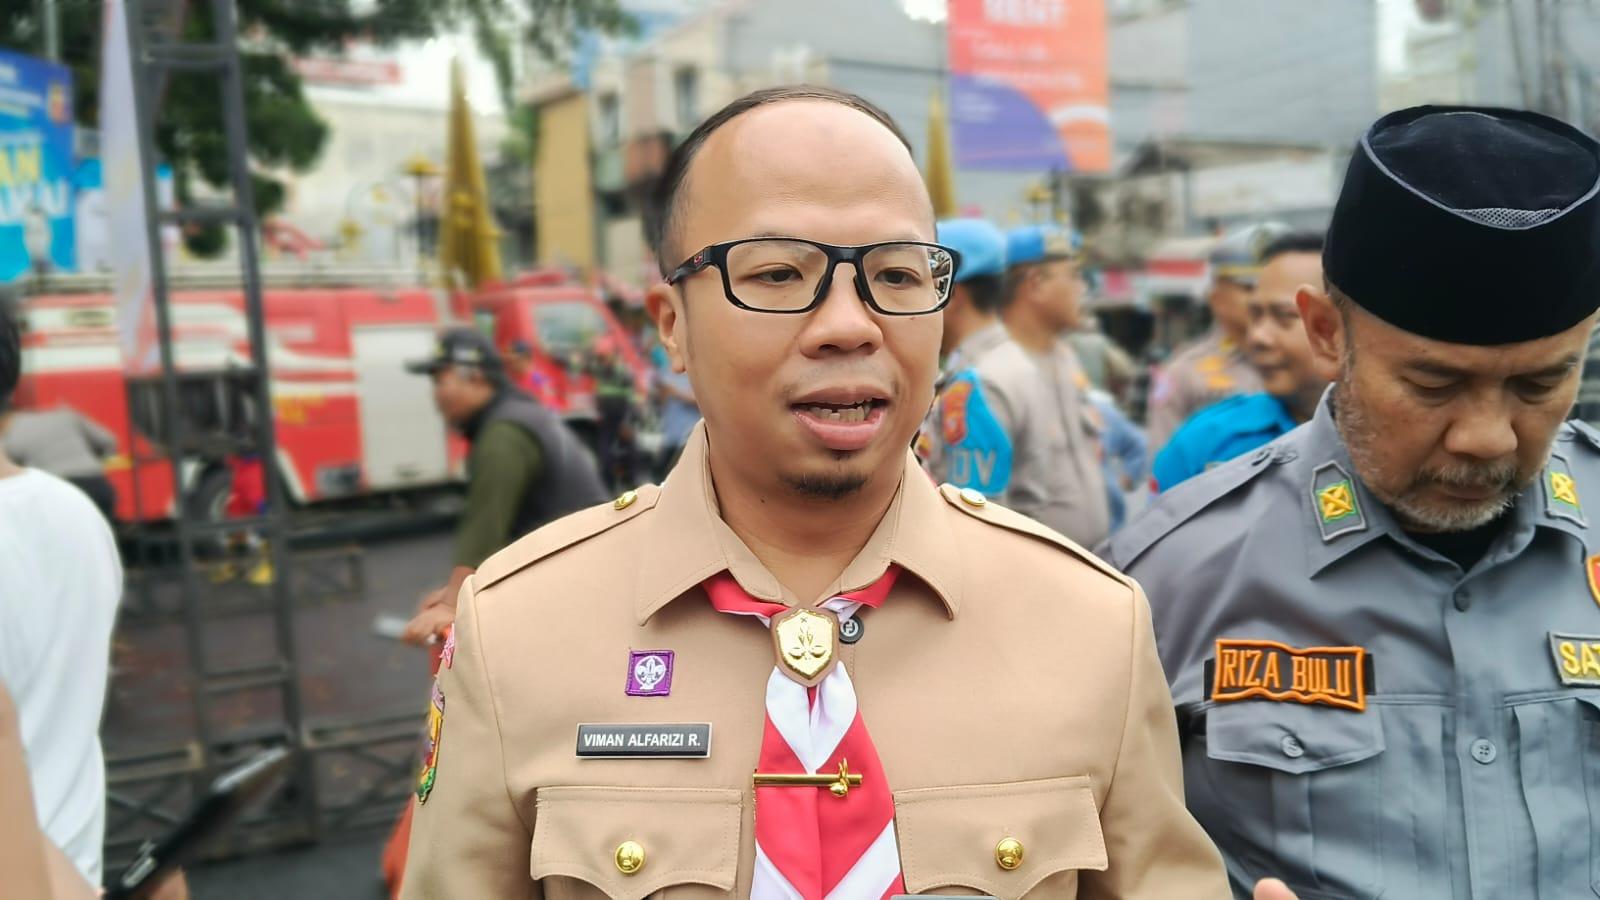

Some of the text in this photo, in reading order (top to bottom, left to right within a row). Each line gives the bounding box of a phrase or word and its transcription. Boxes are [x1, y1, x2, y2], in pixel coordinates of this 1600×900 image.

[1221, 650, 1351, 696] RIZA BULU
[583, 733, 702, 747] VIMAN ALFARIZI R.
